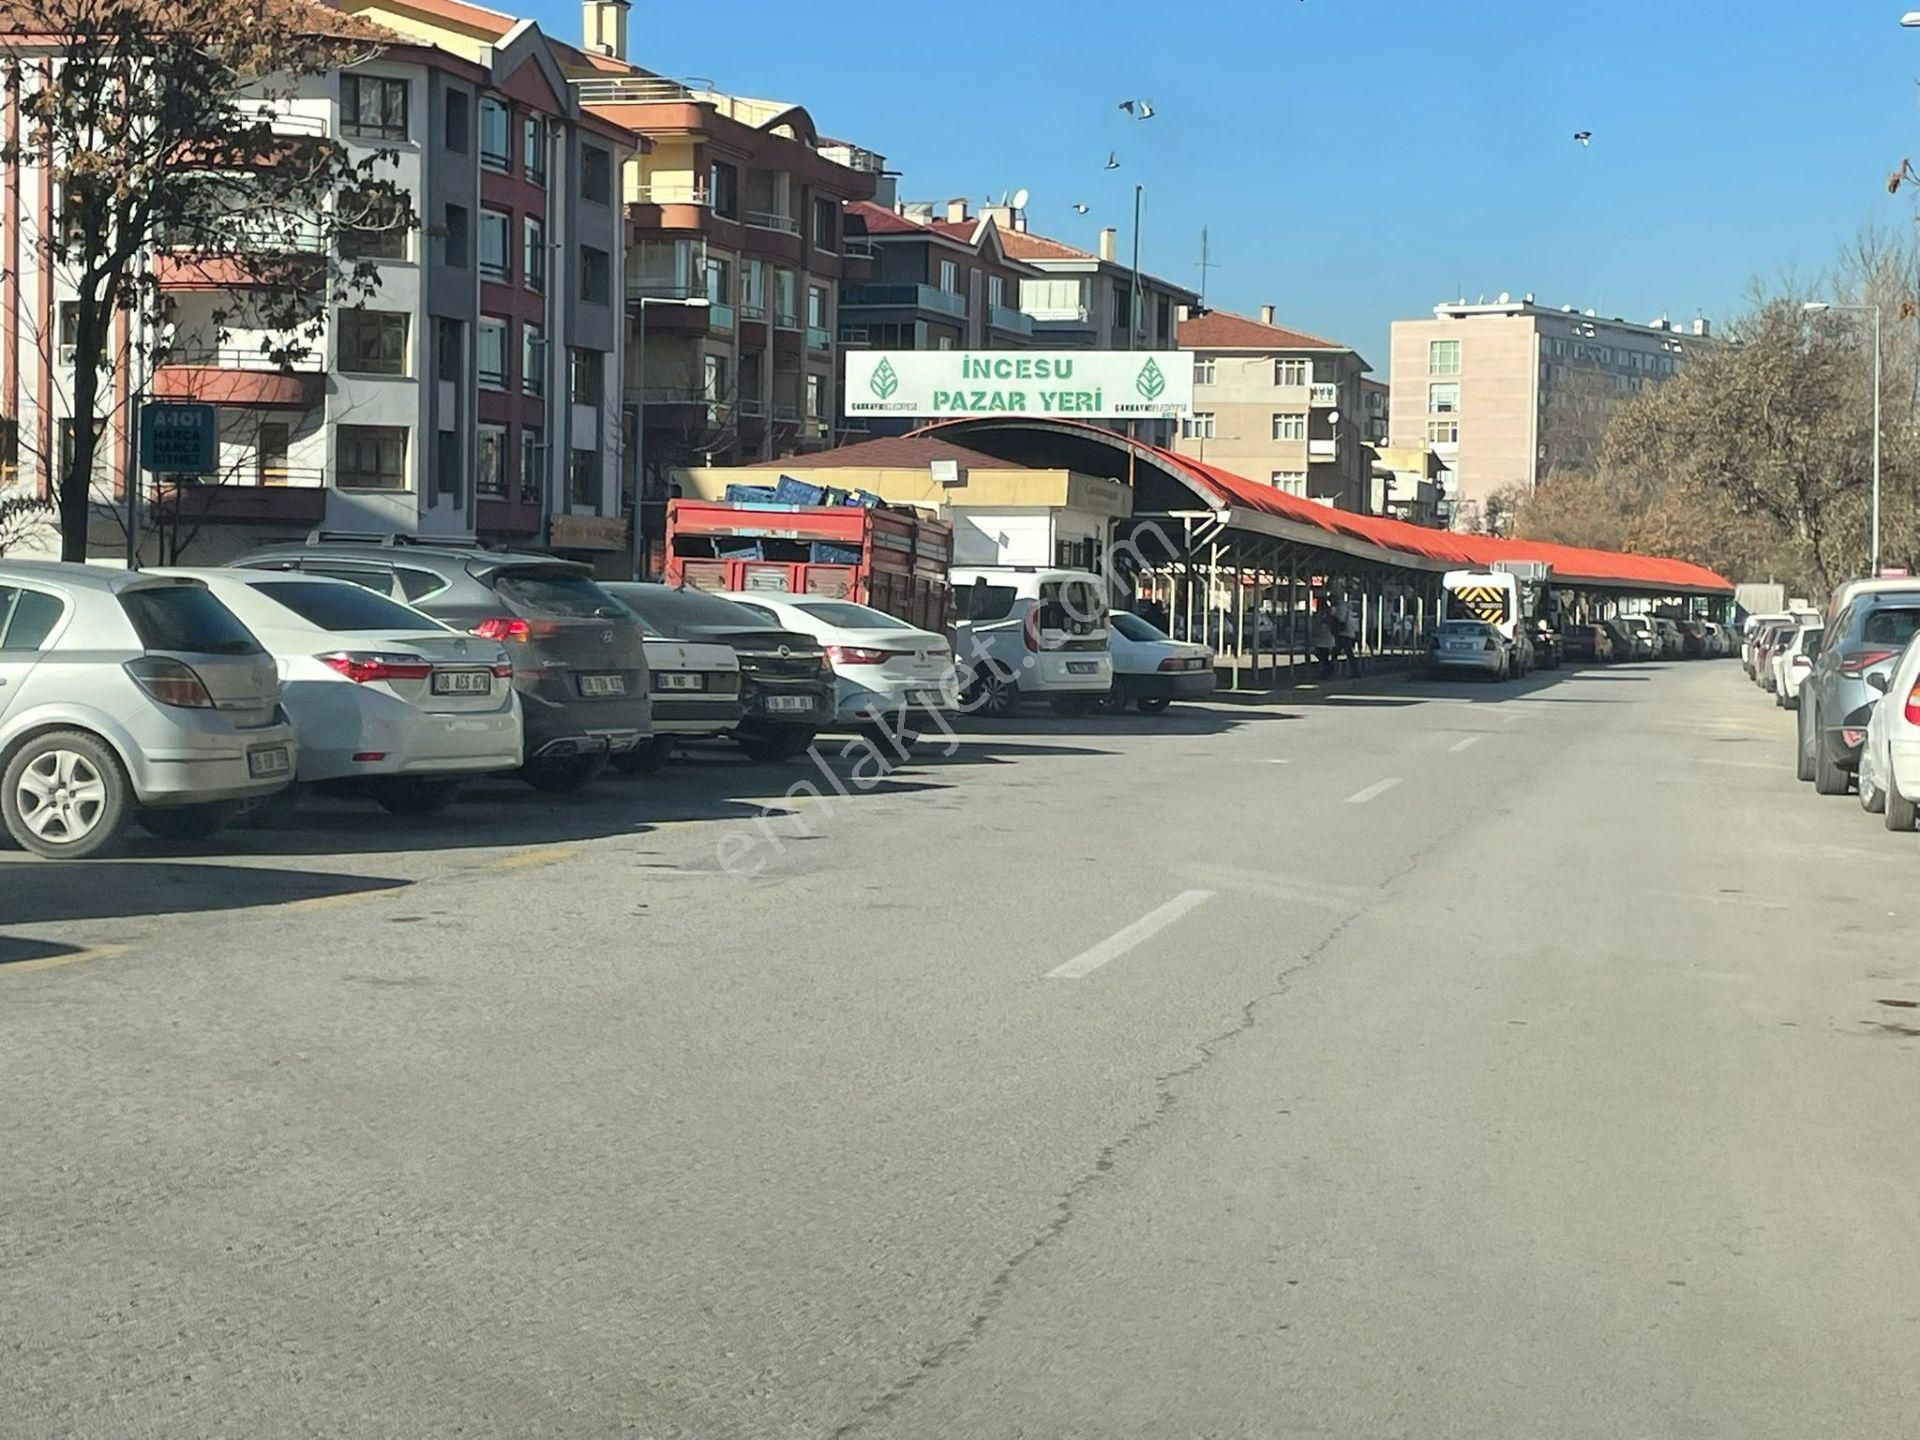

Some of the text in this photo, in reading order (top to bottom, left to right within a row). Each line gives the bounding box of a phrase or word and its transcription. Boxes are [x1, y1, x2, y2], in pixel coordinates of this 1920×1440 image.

[962, 354, 1073, 380] İNCESU
[933, 387, 1103, 412] PAZAR YERİ
[154, 430, 201, 440] HARCA
[154, 442, 201, 452] HARCA
